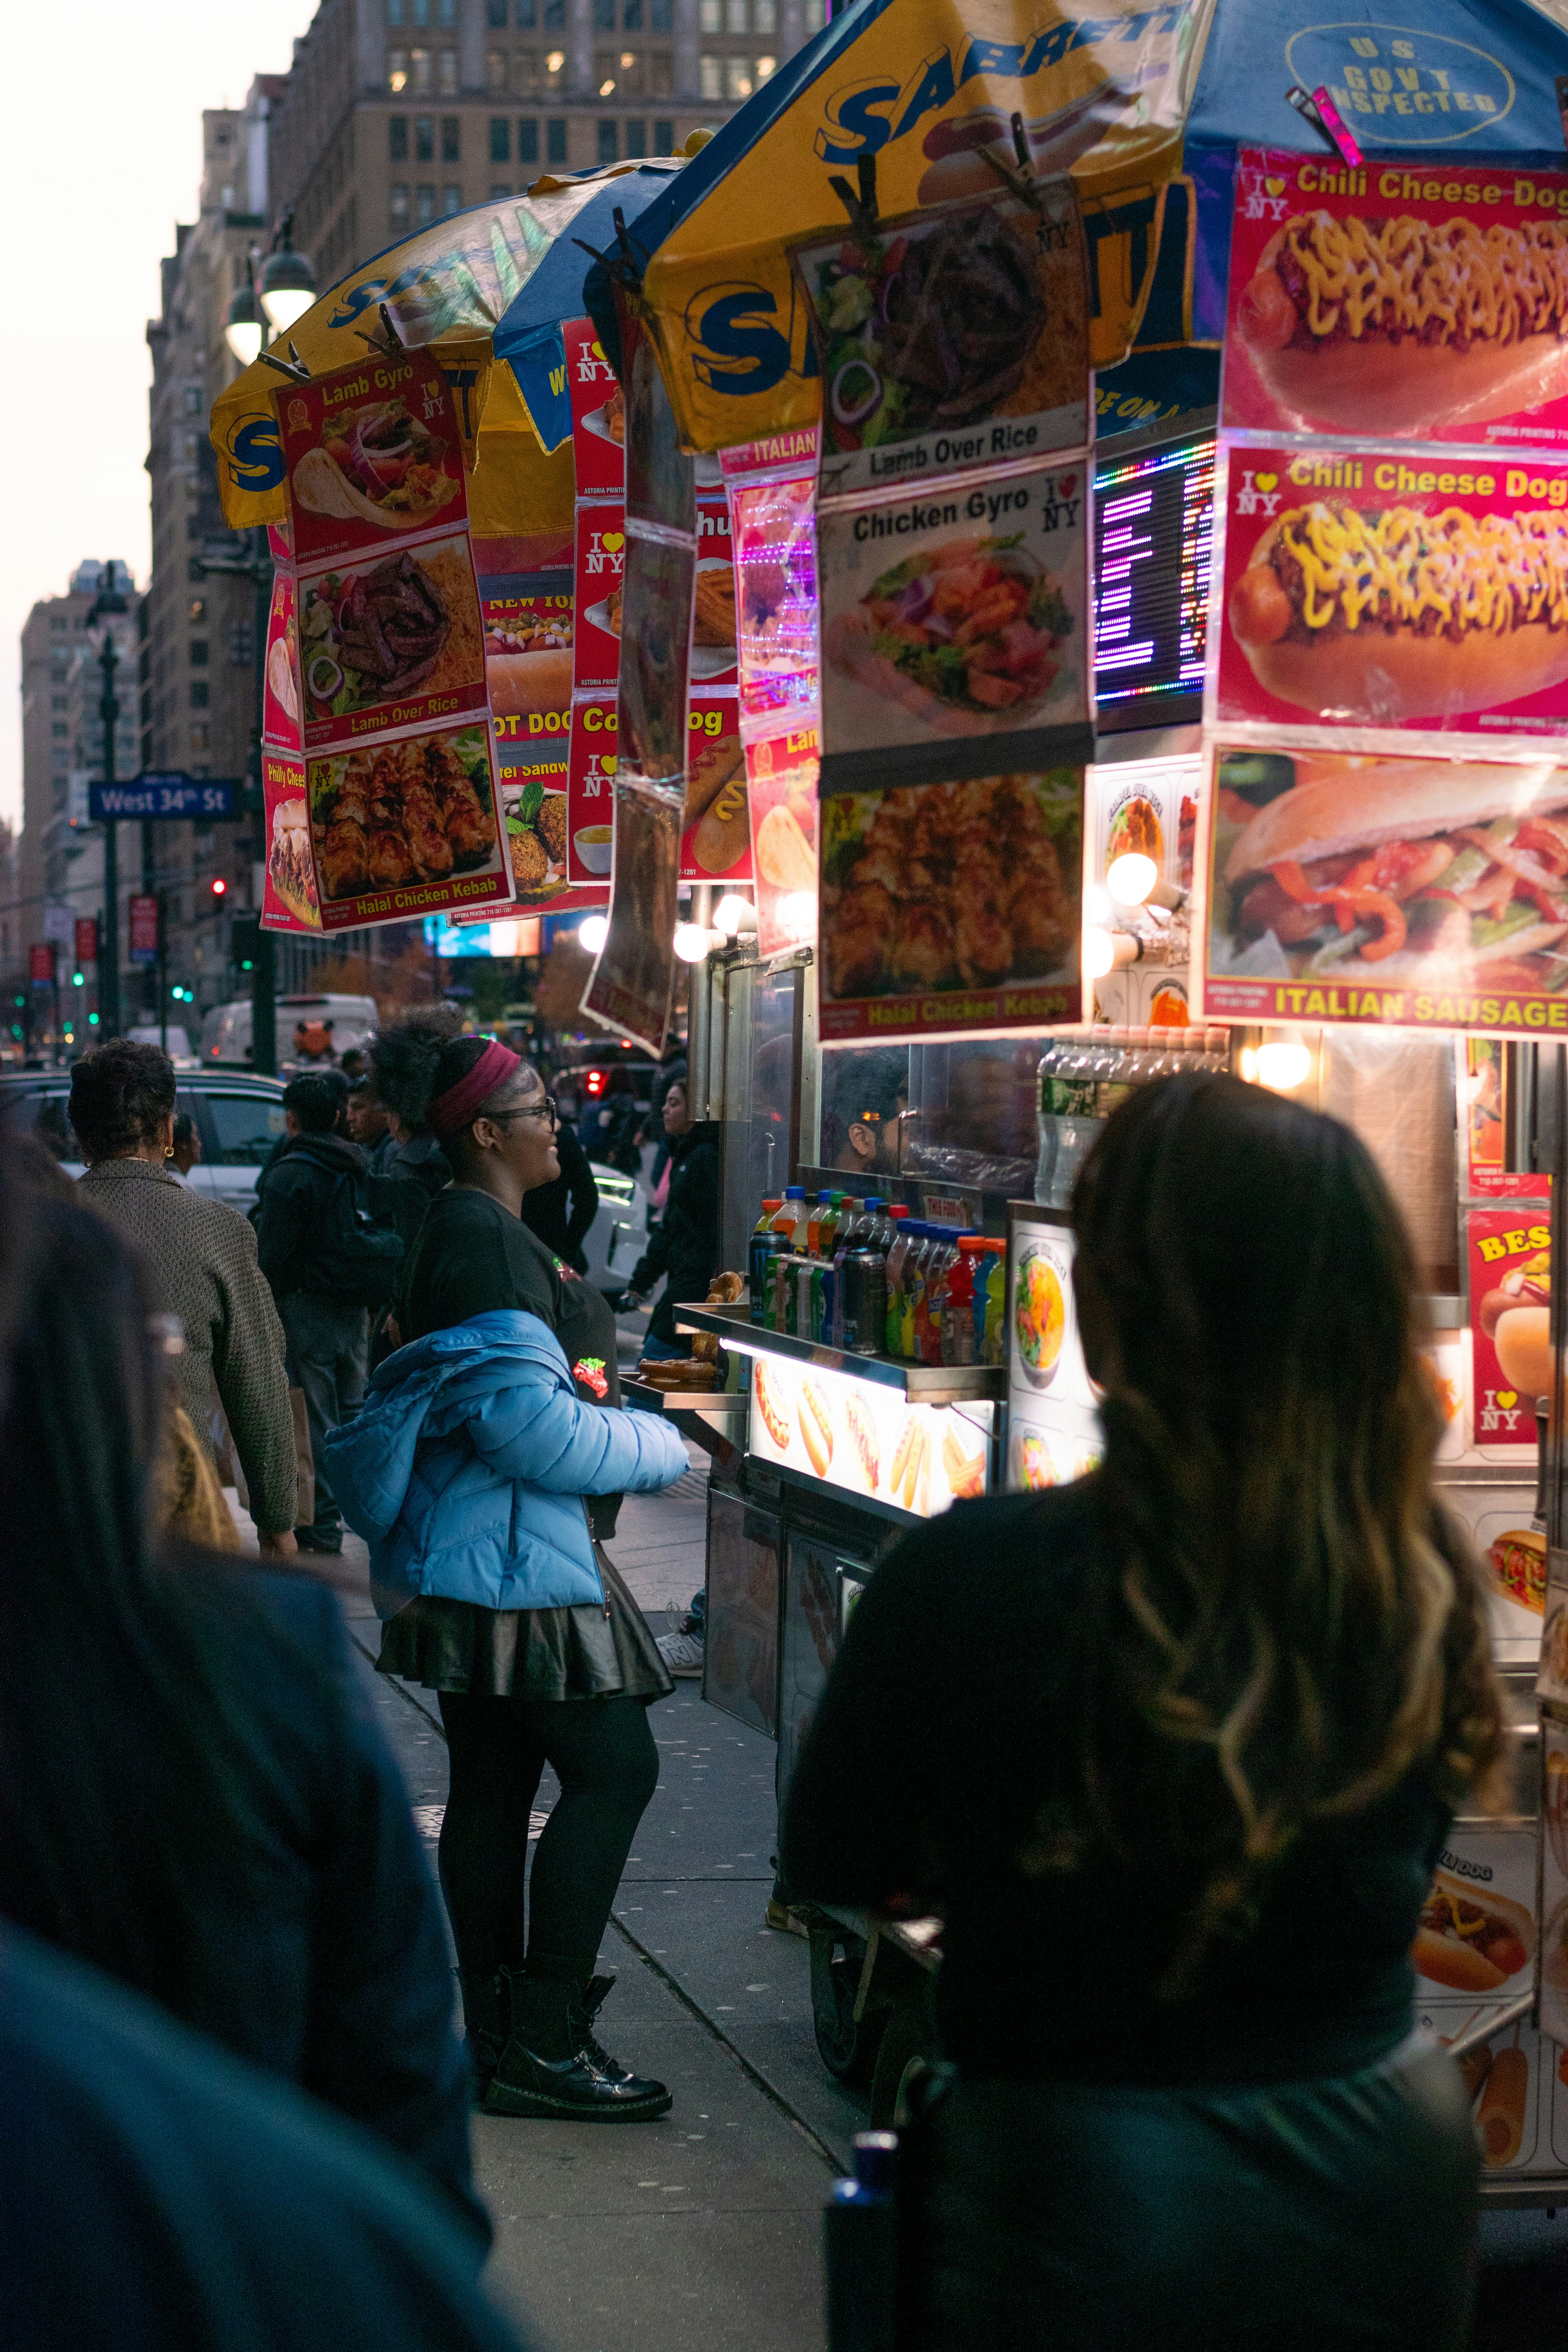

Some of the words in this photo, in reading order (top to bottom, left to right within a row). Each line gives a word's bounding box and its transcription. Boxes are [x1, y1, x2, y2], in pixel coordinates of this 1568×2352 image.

[1330, 85, 1497, 114] NSPECTED
[1298, 164, 1367, 196] Chili
[1379, 168, 1501, 205] Cheese
[1514, 178, 1568, 214] Dog
[1245, 195, 1288, 221] NY
[579, 342, 592, 362] I
[577, 361, 616, 382] NY
[321, 375, 370, 407] Lamb
[375, 364, 414, 390] Gyro
[424, 396, 444, 419] NY
[754, 433, 816, 462] ITALIAN
[870, 446, 927, 475] Lamb
[935, 436, 986, 463] Over
[991, 424, 1038, 454] Rice
[1289, 458, 1363, 489] Chili
[1374, 463, 1495, 496] Cheese
[1507, 470, 1567, 505] Dog
[853, 503, 957, 543] Chicken
[967, 489, 1029, 523] Gyro
[1042, 499, 1080, 532] NY
[1236, 492, 1282, 517] NY
[590, 532, 601, 553] I
[586, 553, 624, 573] NY
[351, 712, 387, 732] Lamb
[392, 703, 422, 722] Over
[428, 696, 458, 715] Rice
[268, 763, 285, 788] Philly
[287, 767, 305, 788] Chees
[588, 754, 599, 776] I
[315, 772, 331, 788] NY
[101, 789, 154, 811] West
[160, 788, 197, 810] 34th
[203, 789, 224, 810] St
[357, 897, 391, 915] Halal
[394, 886, 449, 909] Chicken
[452, 878, 497, 897] Kebab
[487, 907, 512, 915] 718-267-1201
[1276, 987, 1405, 1018] ITALIAN
[1415, 996, 1567, 1027] SAUSAGE
[1477, 1226, 1551, 1262] BES
[1481, 1410, 1521, 1431] NY
